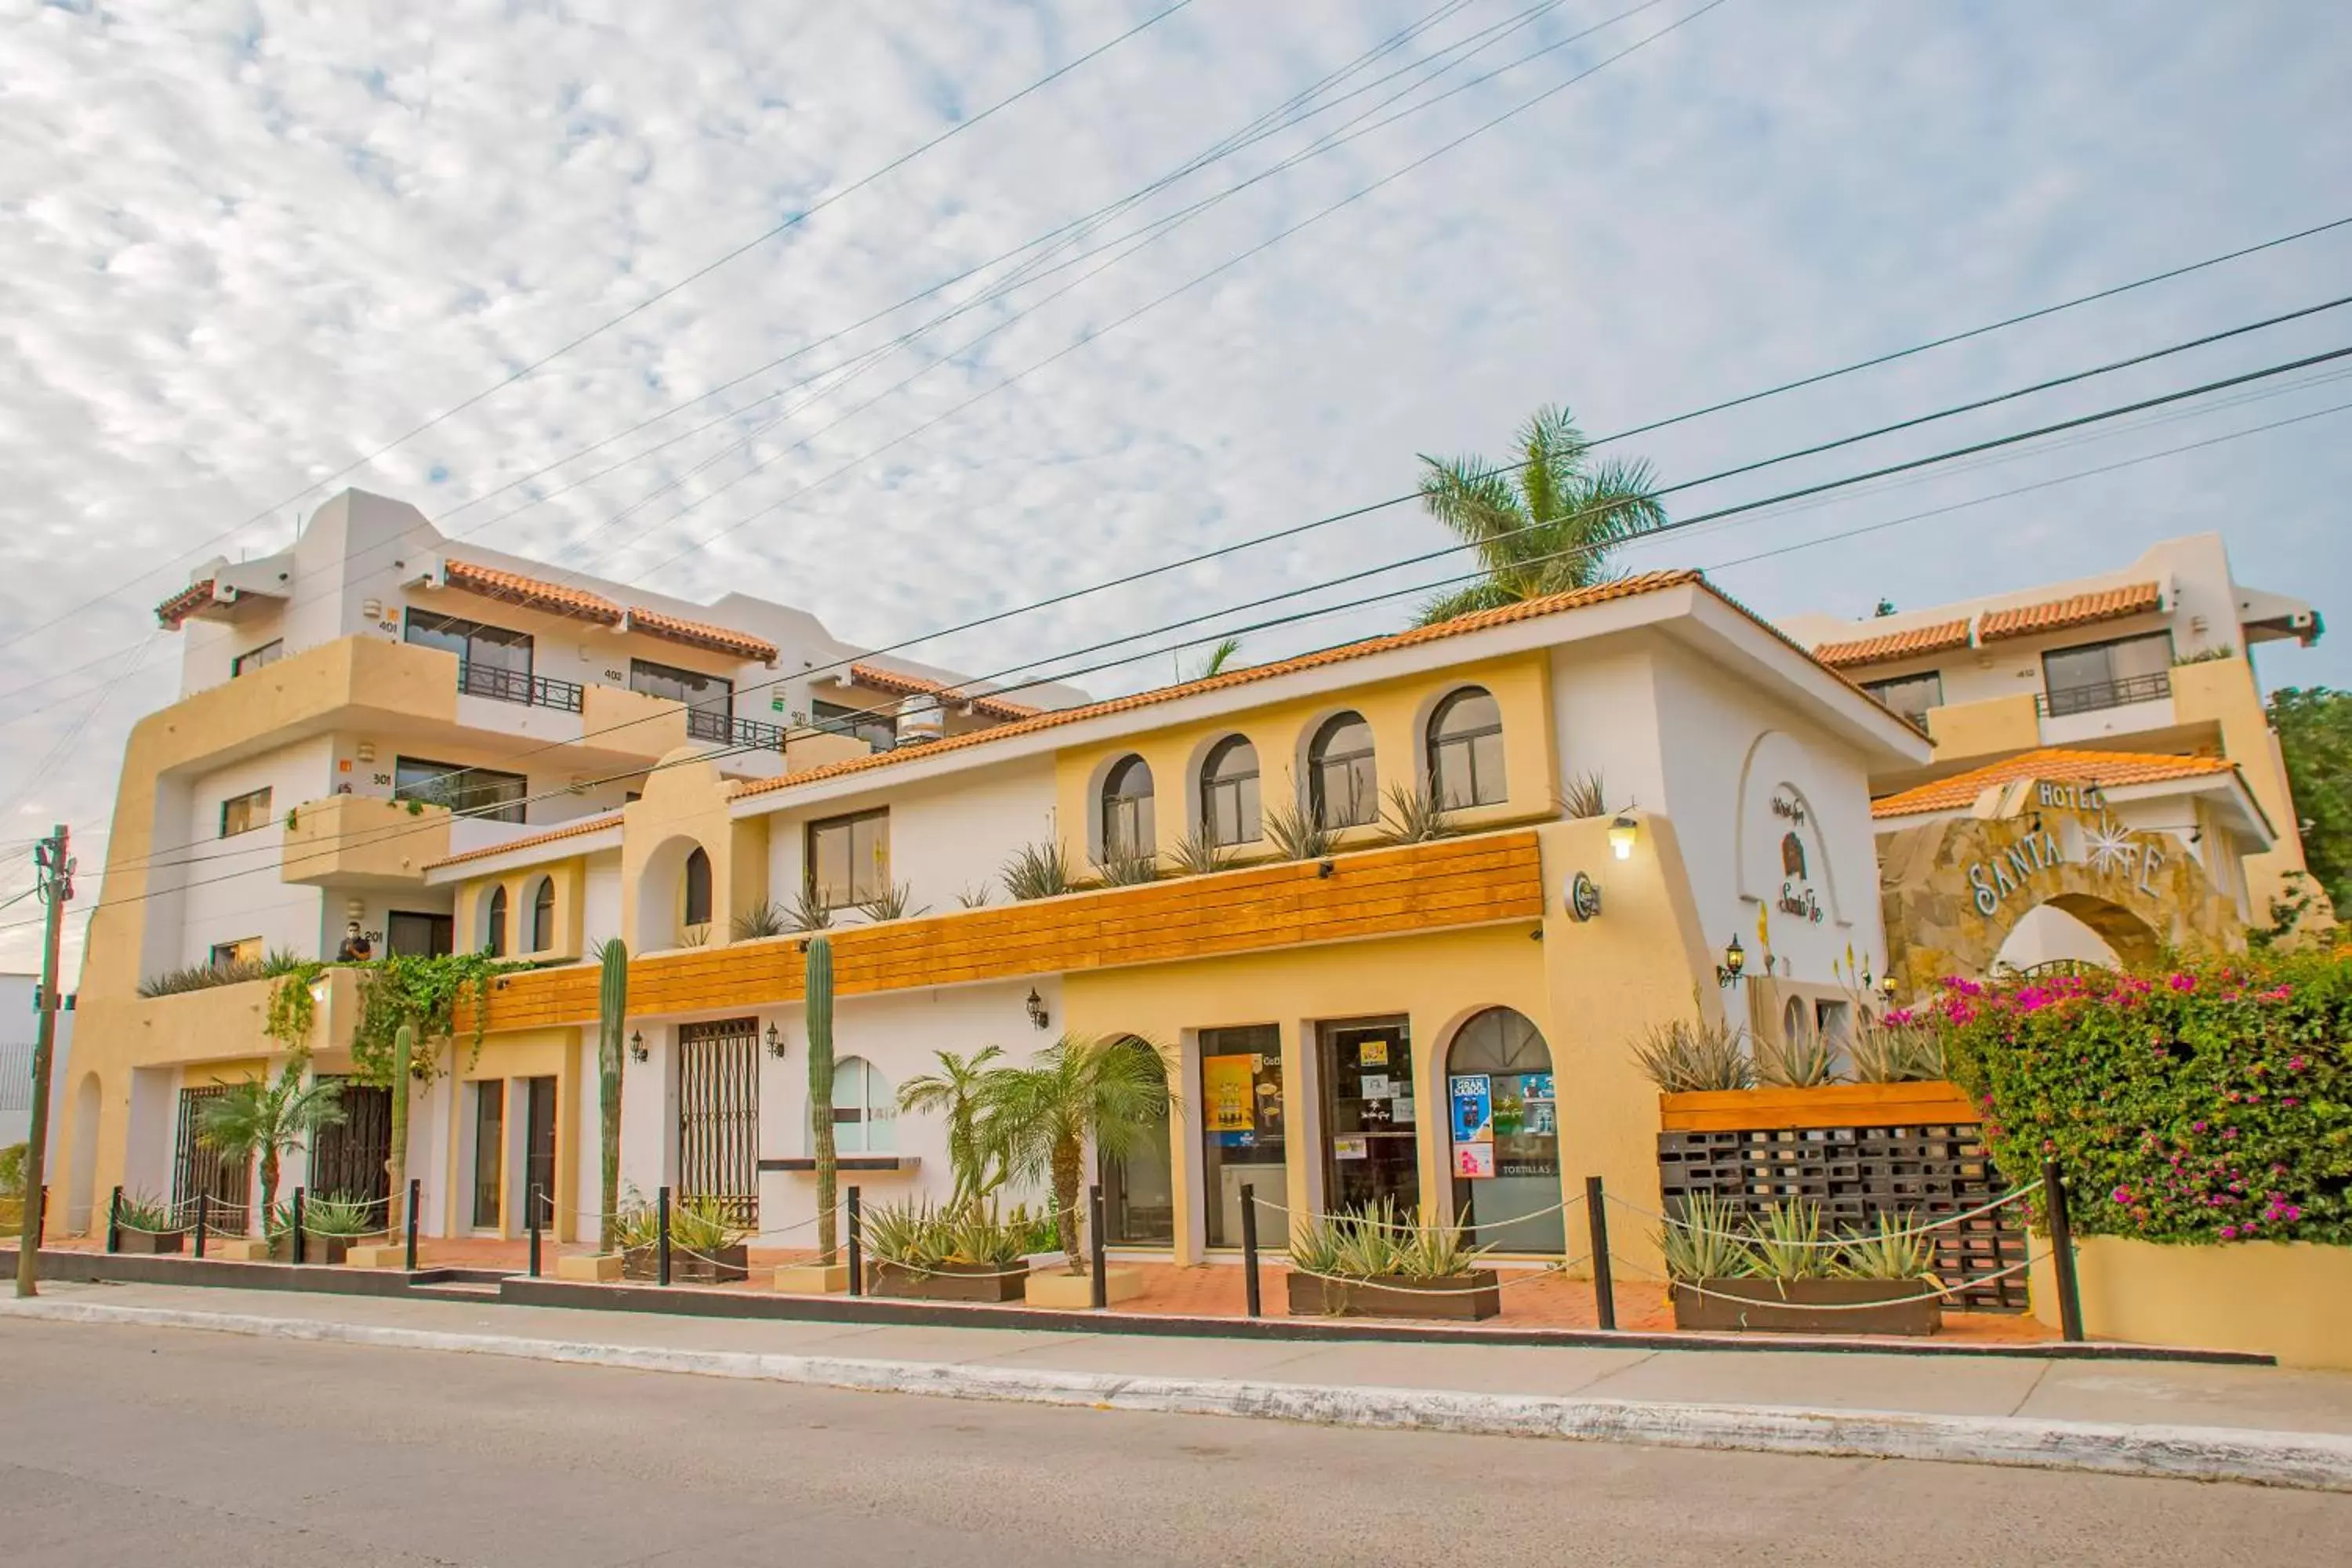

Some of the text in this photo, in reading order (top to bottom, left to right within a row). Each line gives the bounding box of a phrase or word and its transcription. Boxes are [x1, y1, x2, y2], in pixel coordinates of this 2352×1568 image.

[379, 621, 397, 633] 401
[604, 669, 622, 681] 402
[373, 772, 391, 786] 301
[2040, 782, 2103, 811] HOTEL
[1969, 832, 2063, 916] SANTA
[1777, 881, 1808, 916] Santa
[365, 931, 383, 944] 201
[1502, 1165, 1552, 1174] TORTILLAS
